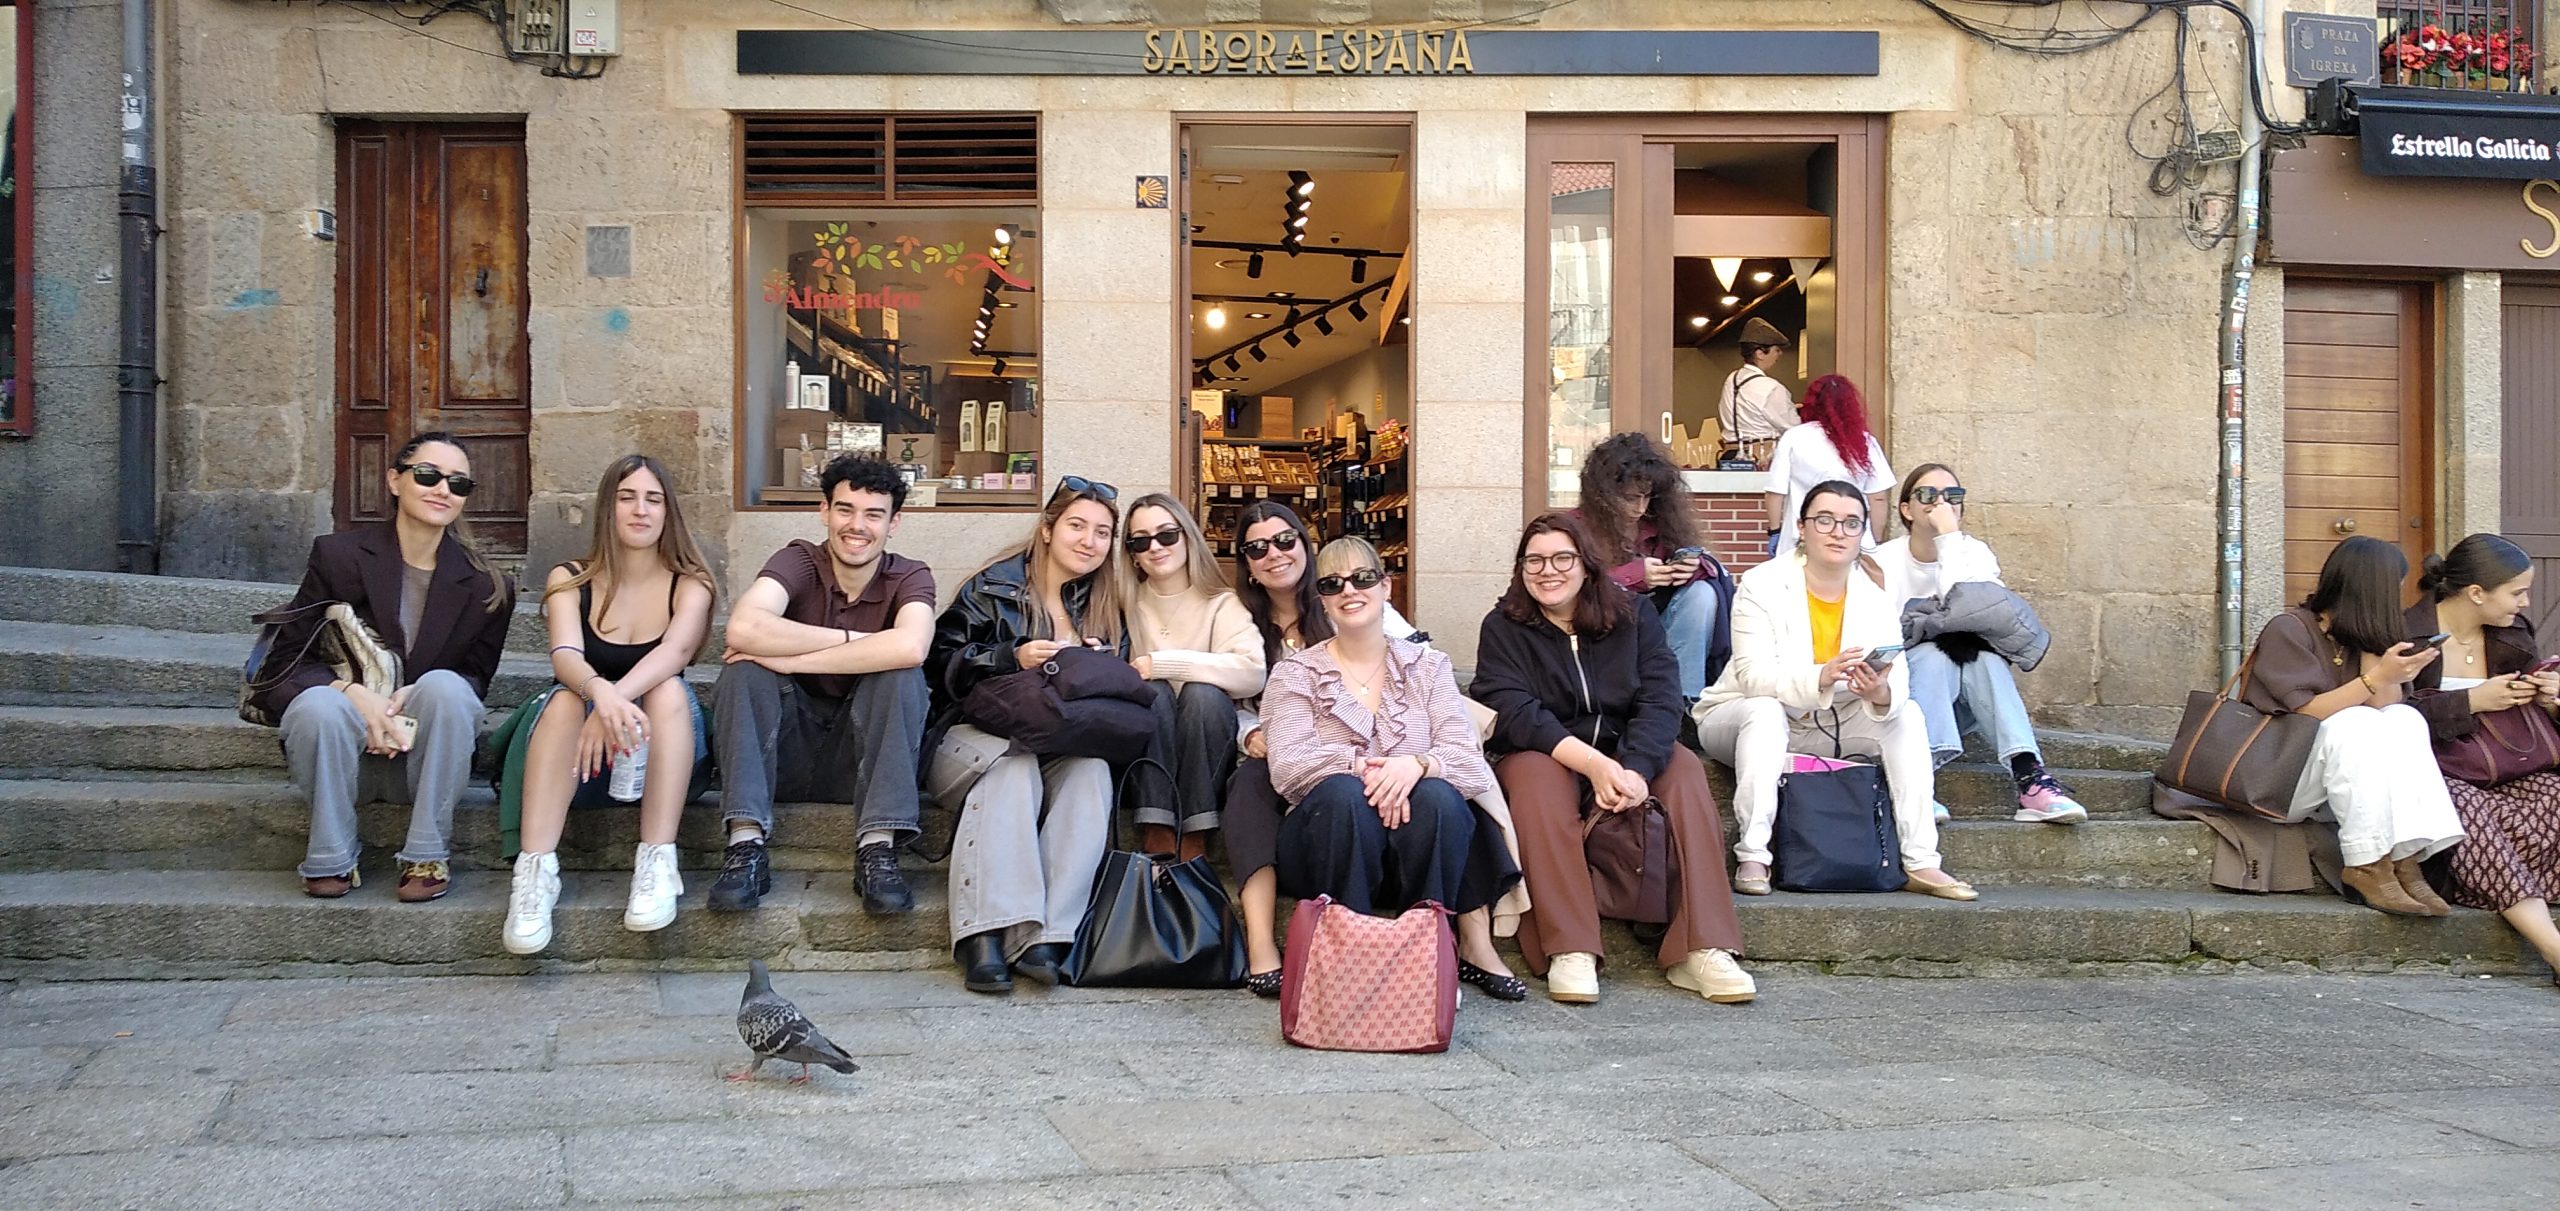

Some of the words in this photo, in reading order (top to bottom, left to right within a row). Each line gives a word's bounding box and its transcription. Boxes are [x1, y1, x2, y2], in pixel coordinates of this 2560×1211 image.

[2321, 28, 2360, 43] PRAZA
[1143, 27, 1278, 74] SABOR
[1284, 34, 1309, 70] A
[1315, 28, 1474, 74] ESPAÑA
[2333, 45, 2348, 56] DA
[2310, 59, 2358, 74] IGREXA
[2391, 133, 2474, 158] Estrella
[2475, 136, 2551, 161] Galicia
[785, 285, 921, 311] Almendro
